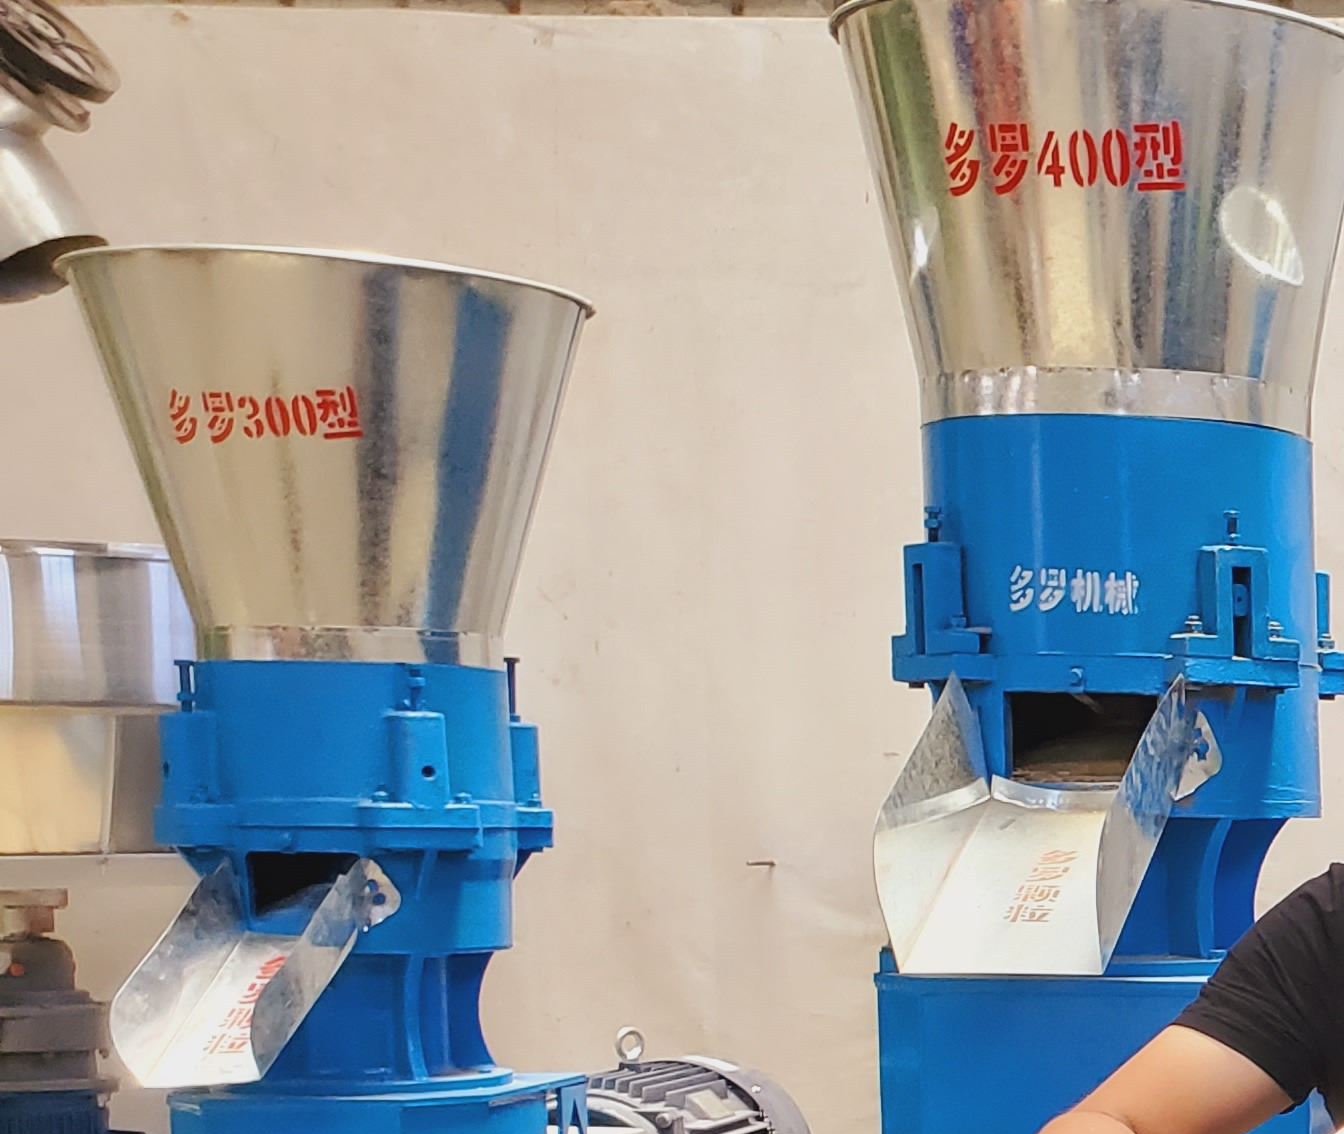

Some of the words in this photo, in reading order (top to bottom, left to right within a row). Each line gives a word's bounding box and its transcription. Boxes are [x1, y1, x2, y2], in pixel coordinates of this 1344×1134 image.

[945, 120, 1186, 197] 多罗400型
[169, 386, 364, 444] 多罗300型
[1009, 565, 1140, 615] 多罗机械
[1003, 849, 1077, 922] 多罗颗粒
